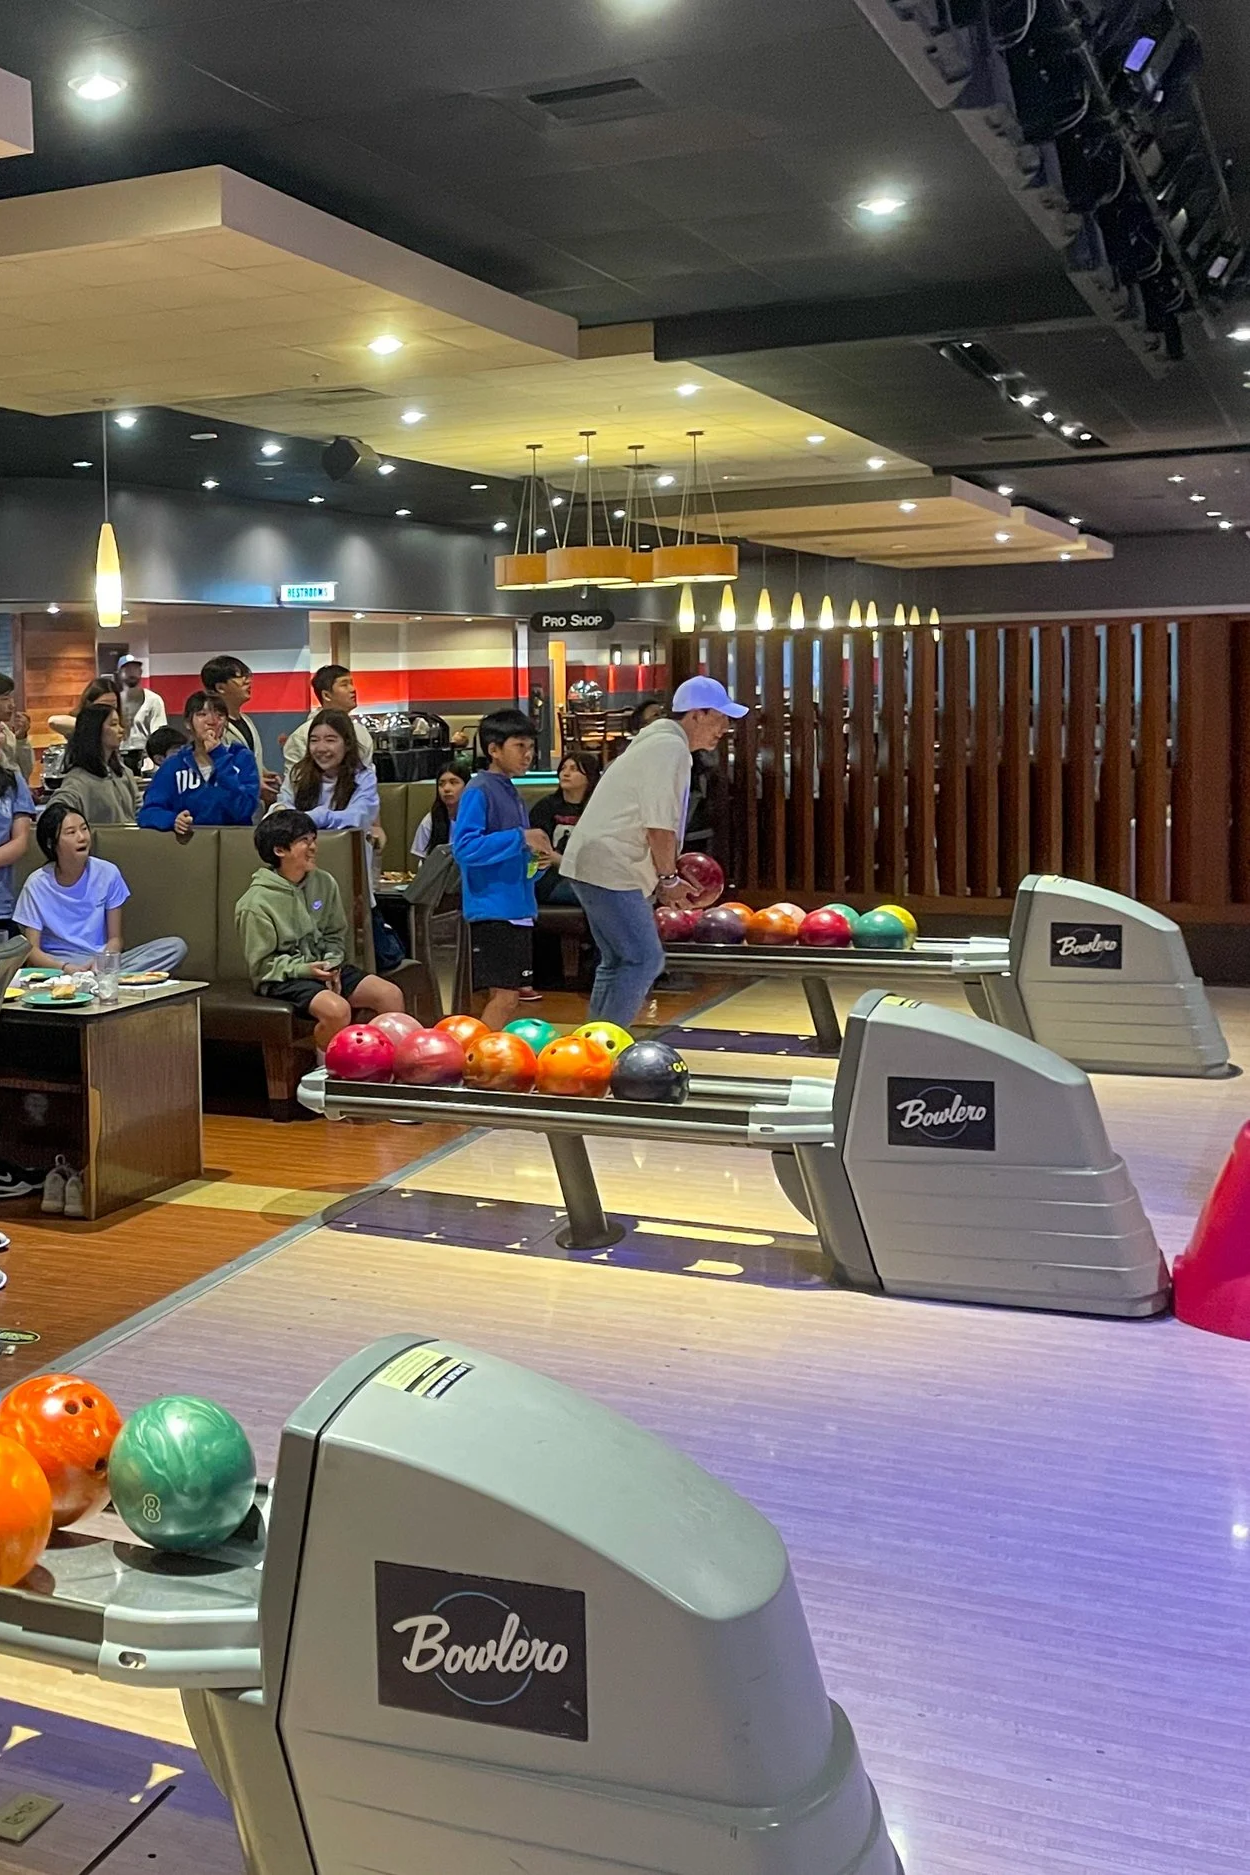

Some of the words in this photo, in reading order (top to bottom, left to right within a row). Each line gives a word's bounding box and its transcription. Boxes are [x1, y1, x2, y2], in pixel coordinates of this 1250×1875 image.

[570, 614, 603, 627] SHOP
[1056, 933, 1117, 956] Bowlero
[896, 1094, 987, 1129] Bowlero
[142, 1493, 161, 1523] 8
[393, 1612, 569, 1674] Bowlero
